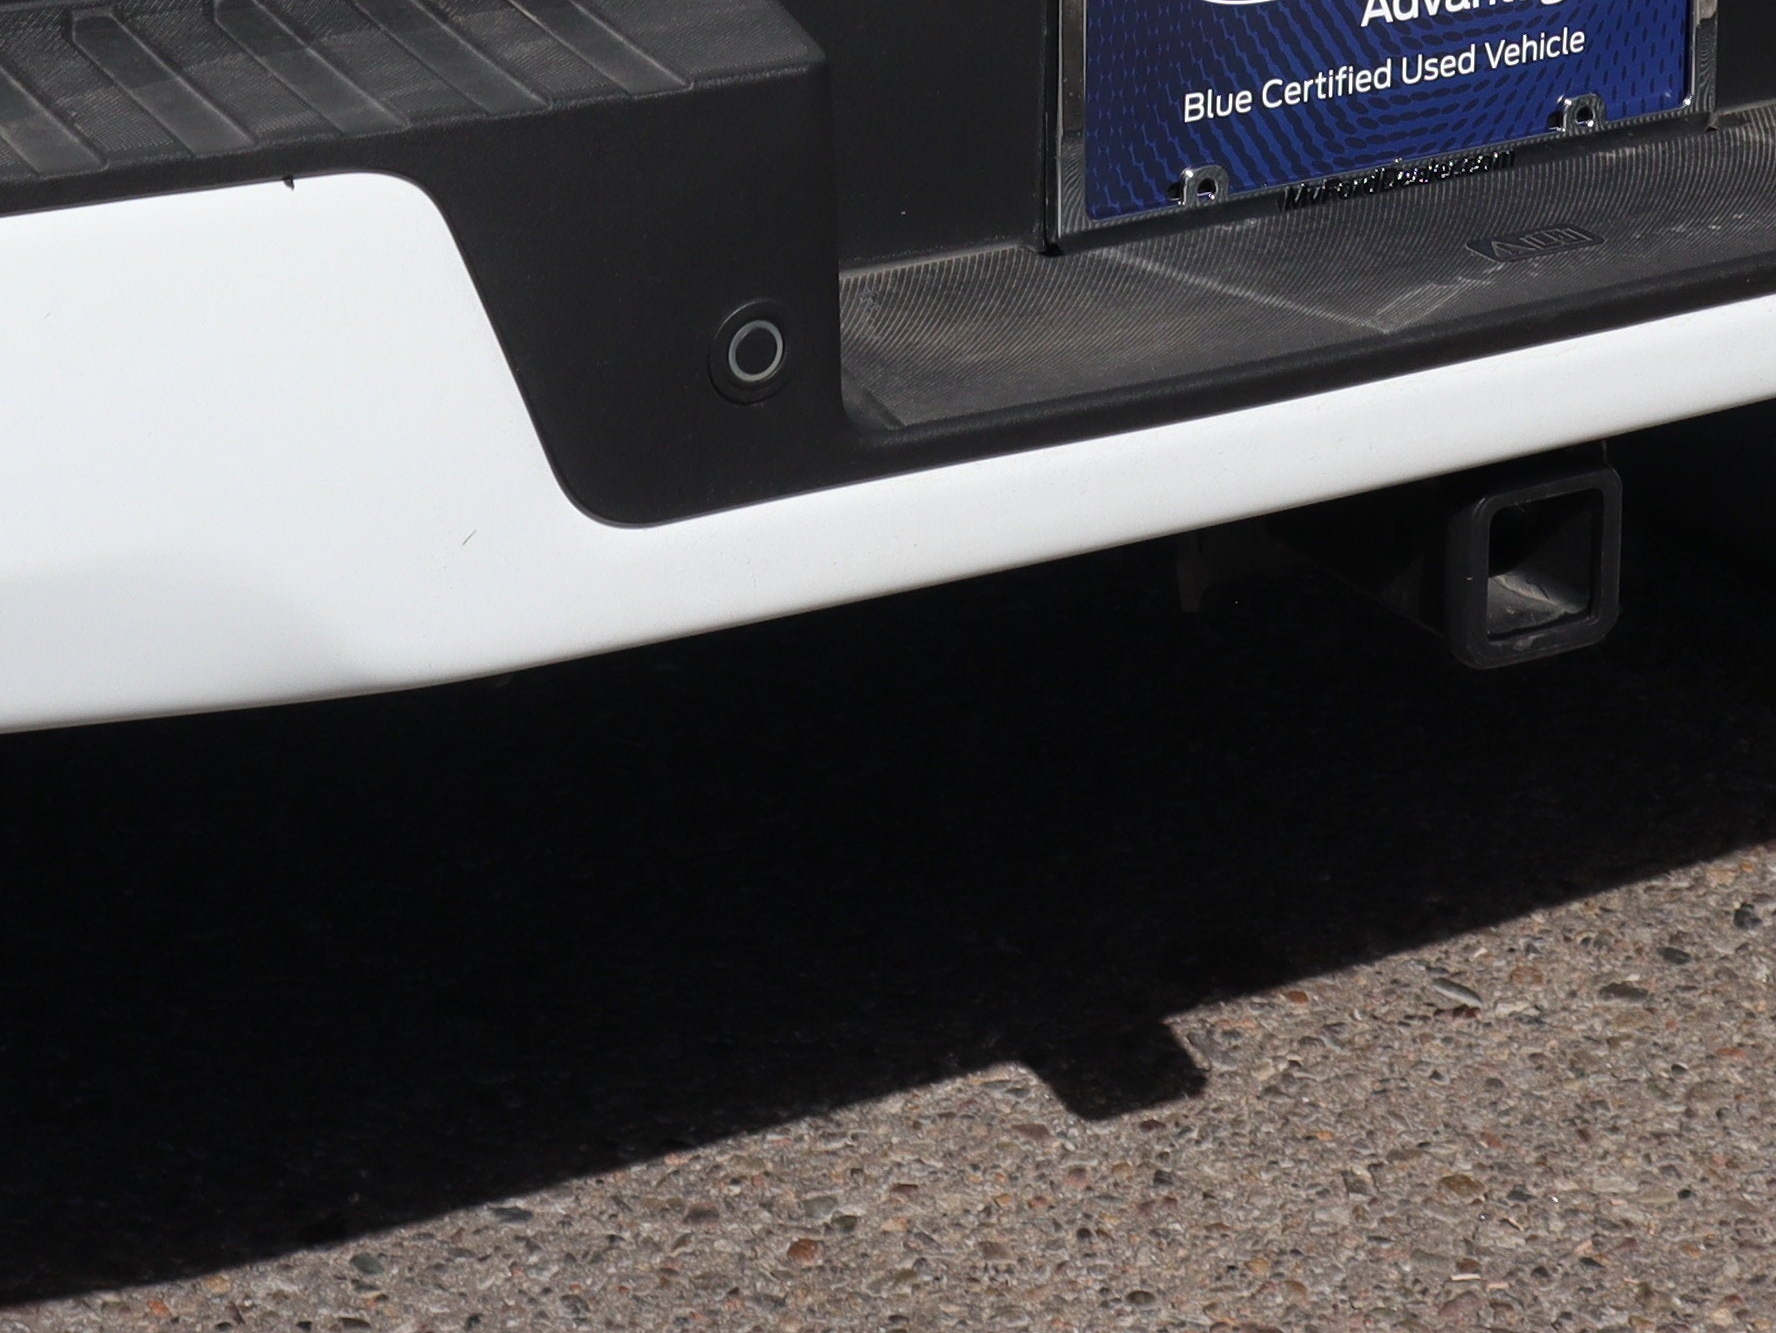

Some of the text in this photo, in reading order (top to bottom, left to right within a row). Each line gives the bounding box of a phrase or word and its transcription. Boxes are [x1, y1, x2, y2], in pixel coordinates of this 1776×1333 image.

[1183, 27, 1586, 123] Blue Certified Used Vehicle
